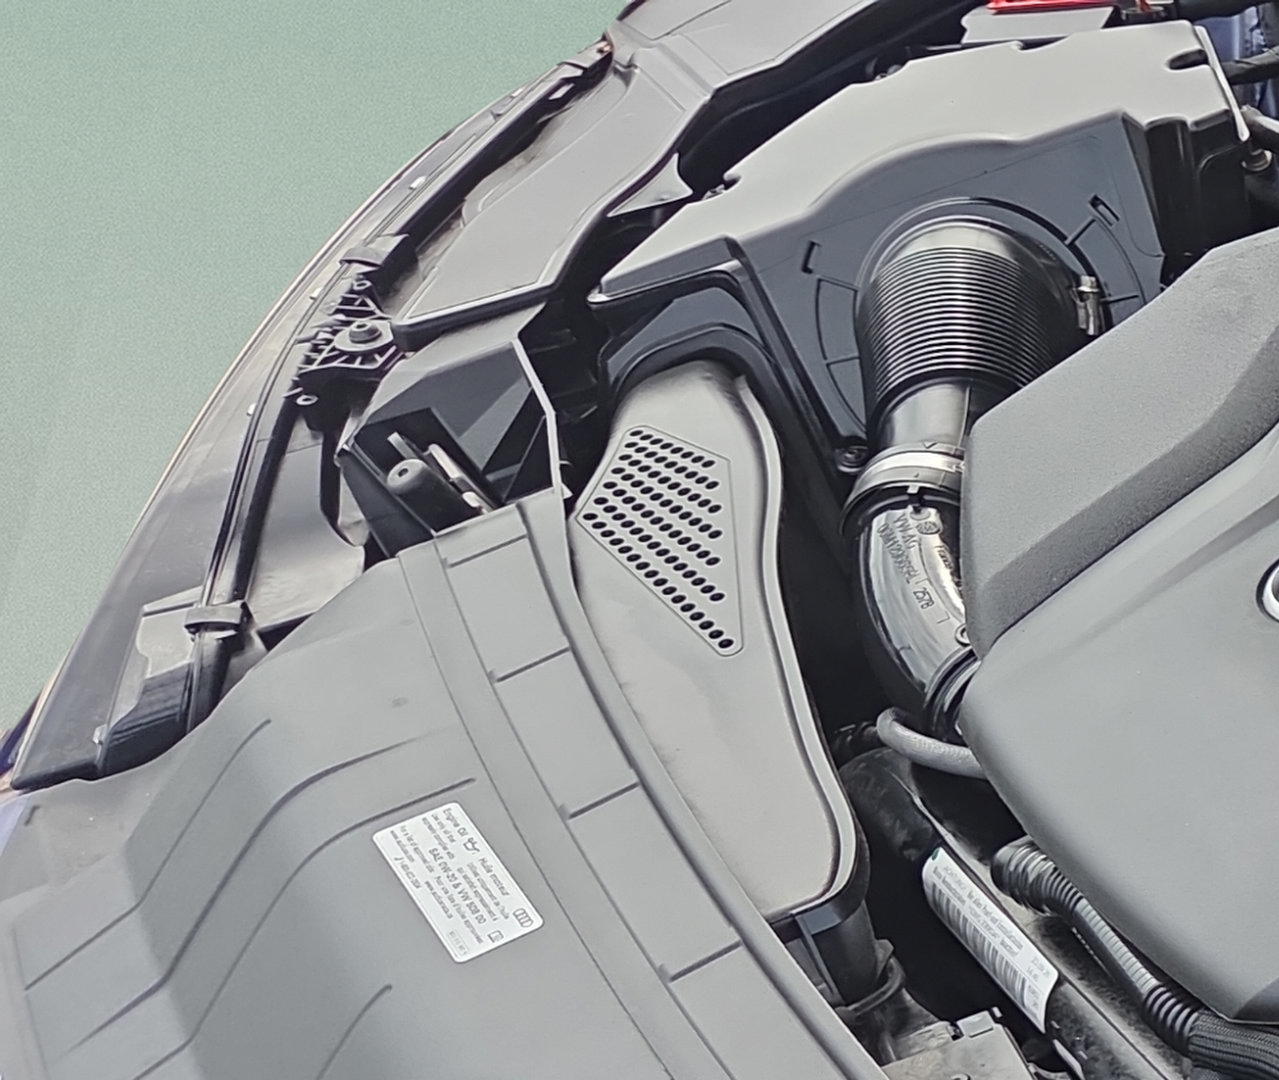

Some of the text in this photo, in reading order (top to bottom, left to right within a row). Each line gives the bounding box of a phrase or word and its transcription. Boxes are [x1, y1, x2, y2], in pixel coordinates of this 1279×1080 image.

[440, 807, 469, 837] Engine Oil
[427, 846, 444, 862] SAE
[477, 855, 496, 874] Huile
[488, 872, 511, 897] moteur
[451, 880, 463, 889] &
[456, 887, 473, 903] VW
